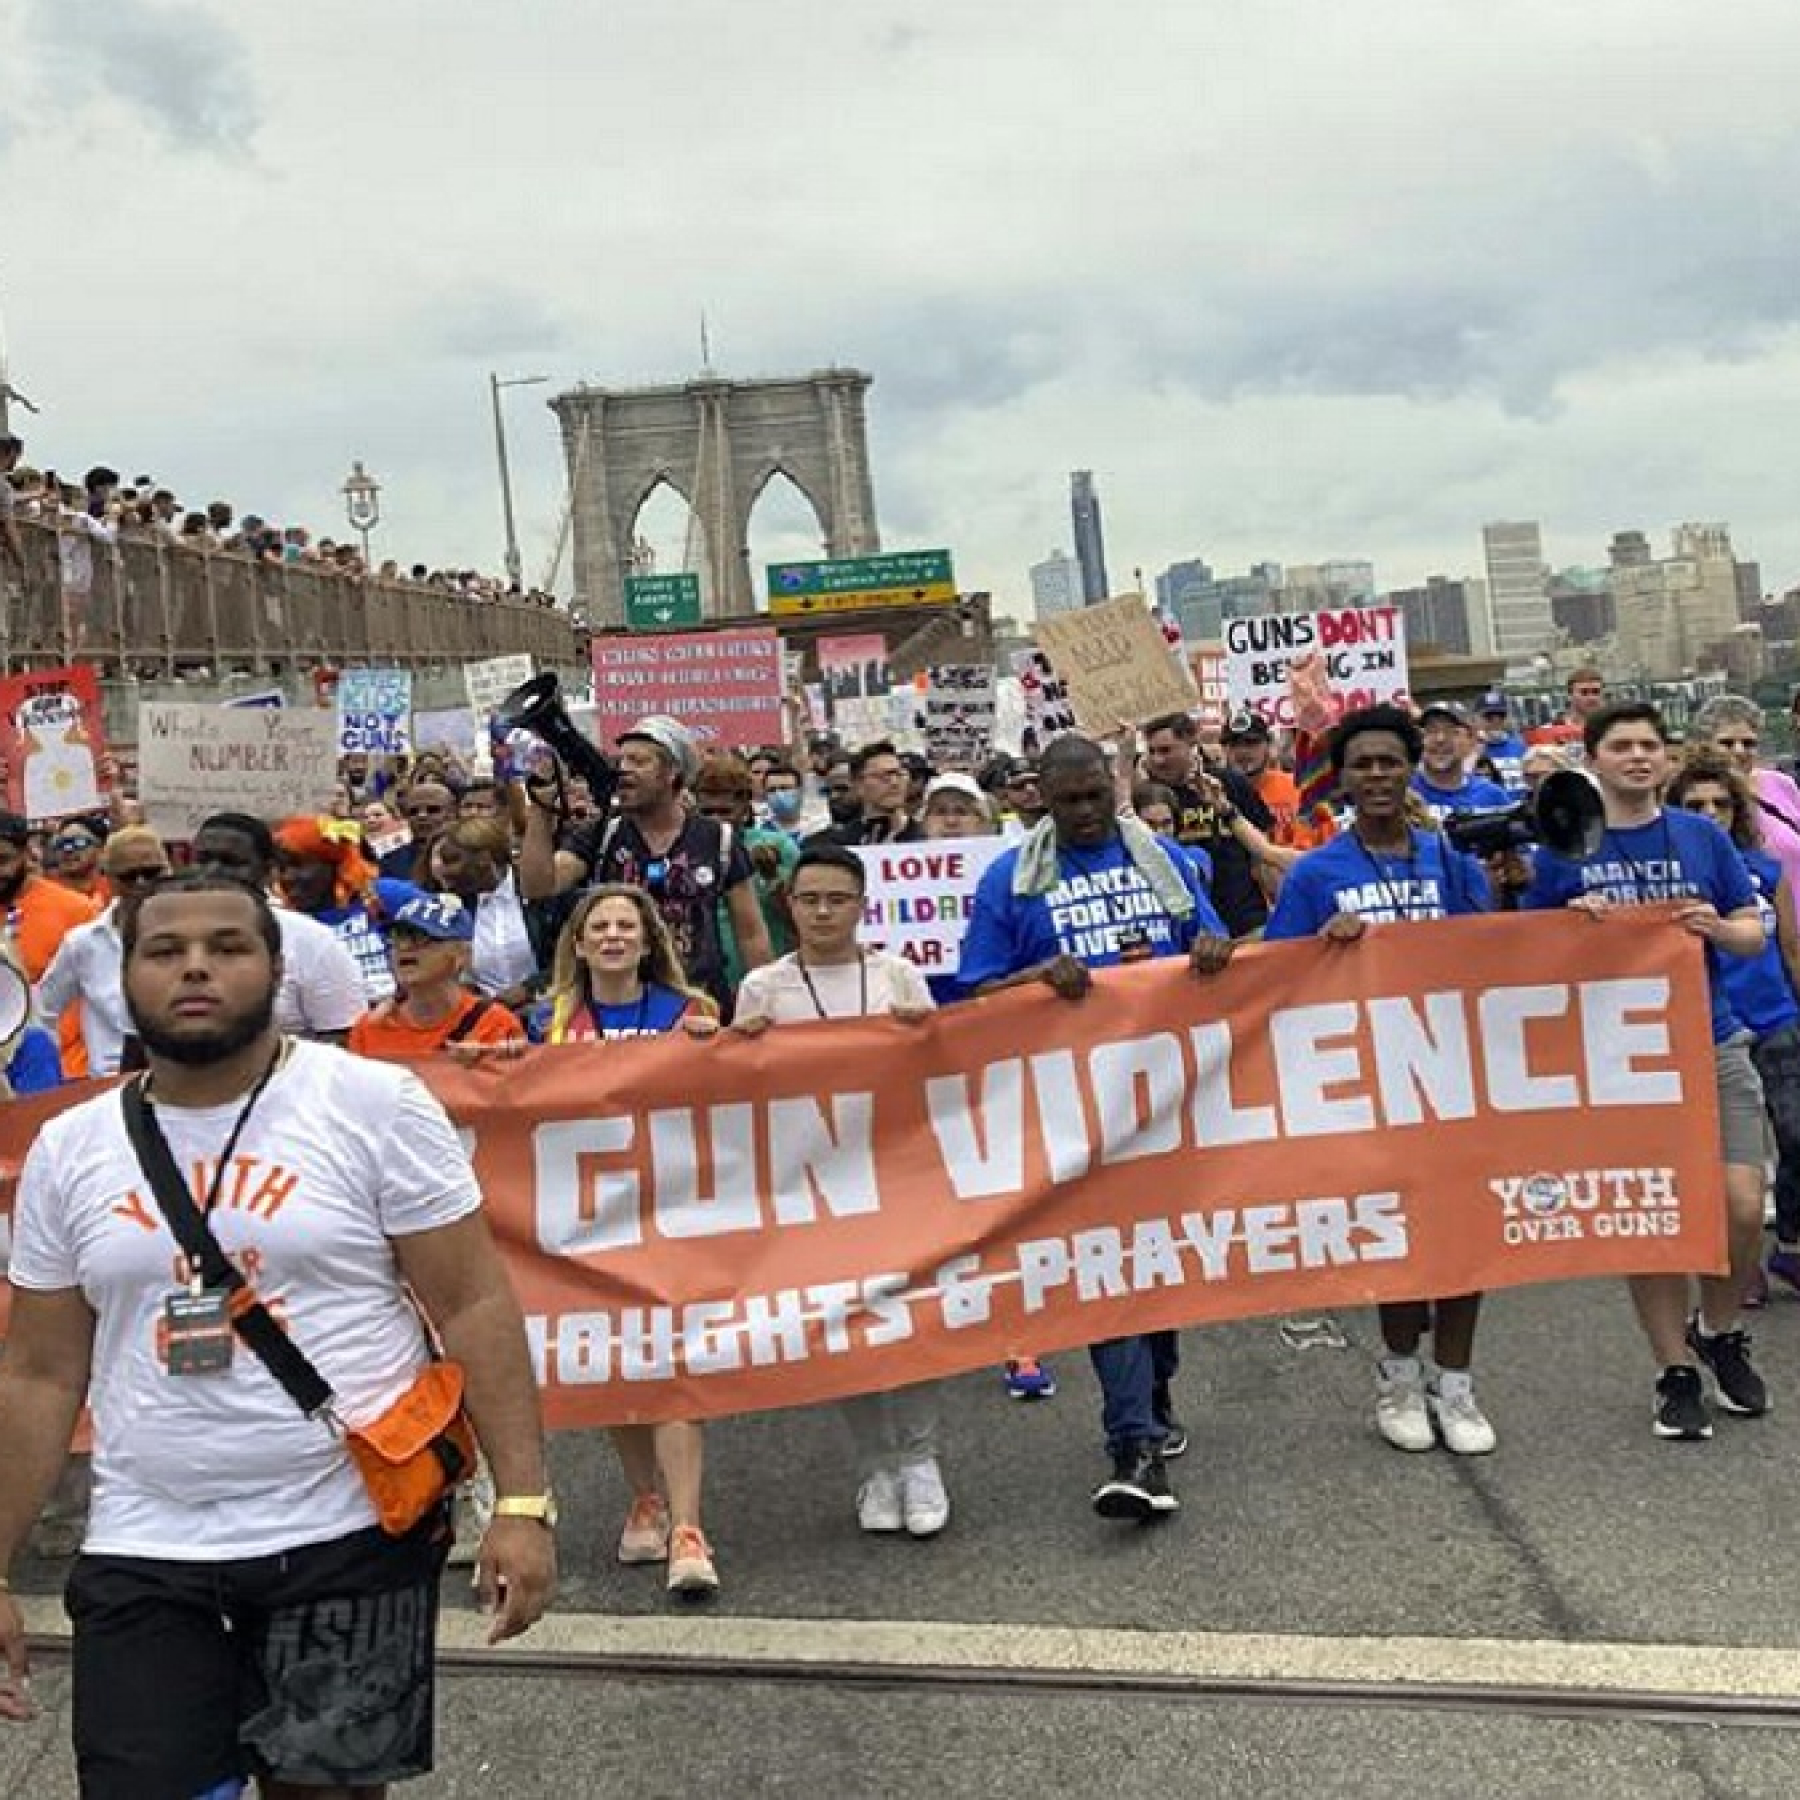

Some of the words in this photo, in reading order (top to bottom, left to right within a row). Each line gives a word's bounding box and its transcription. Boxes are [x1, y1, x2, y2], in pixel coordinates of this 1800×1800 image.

[1228, 614, 1315, 653] GUNS
[1252, 651, 1353, 686] BEG
[1361, 650, 1396, 671] IN
[343, 711, 399, 730] NOT
[188, 743, 290, 773] NUMBER
[340, 729, 405, 753] GUNS
[881, 852, 965, 883] LOVE
[863, 892, 977, 926] HILDRE
[1052, 900, 1111, 935] FOR
[901, 938, 956, 966] AR-
[1059, 921, 1142, 958] LIVE
[533, 1090, 880, 1256] GUN
[925, 977, 1684, 1200] VIOLENCE
[111, 1154, 299, 1233] YUTH
[1503, 1212, 1585, 1246] OVER
[1591, 1210, 1681, 1238] GUNS
[523, 1271, 914, 1389] OUGHTS
[935, 1253, 992, 1330] &
[1017, 1190, 1409, 1316] PRAYERS
